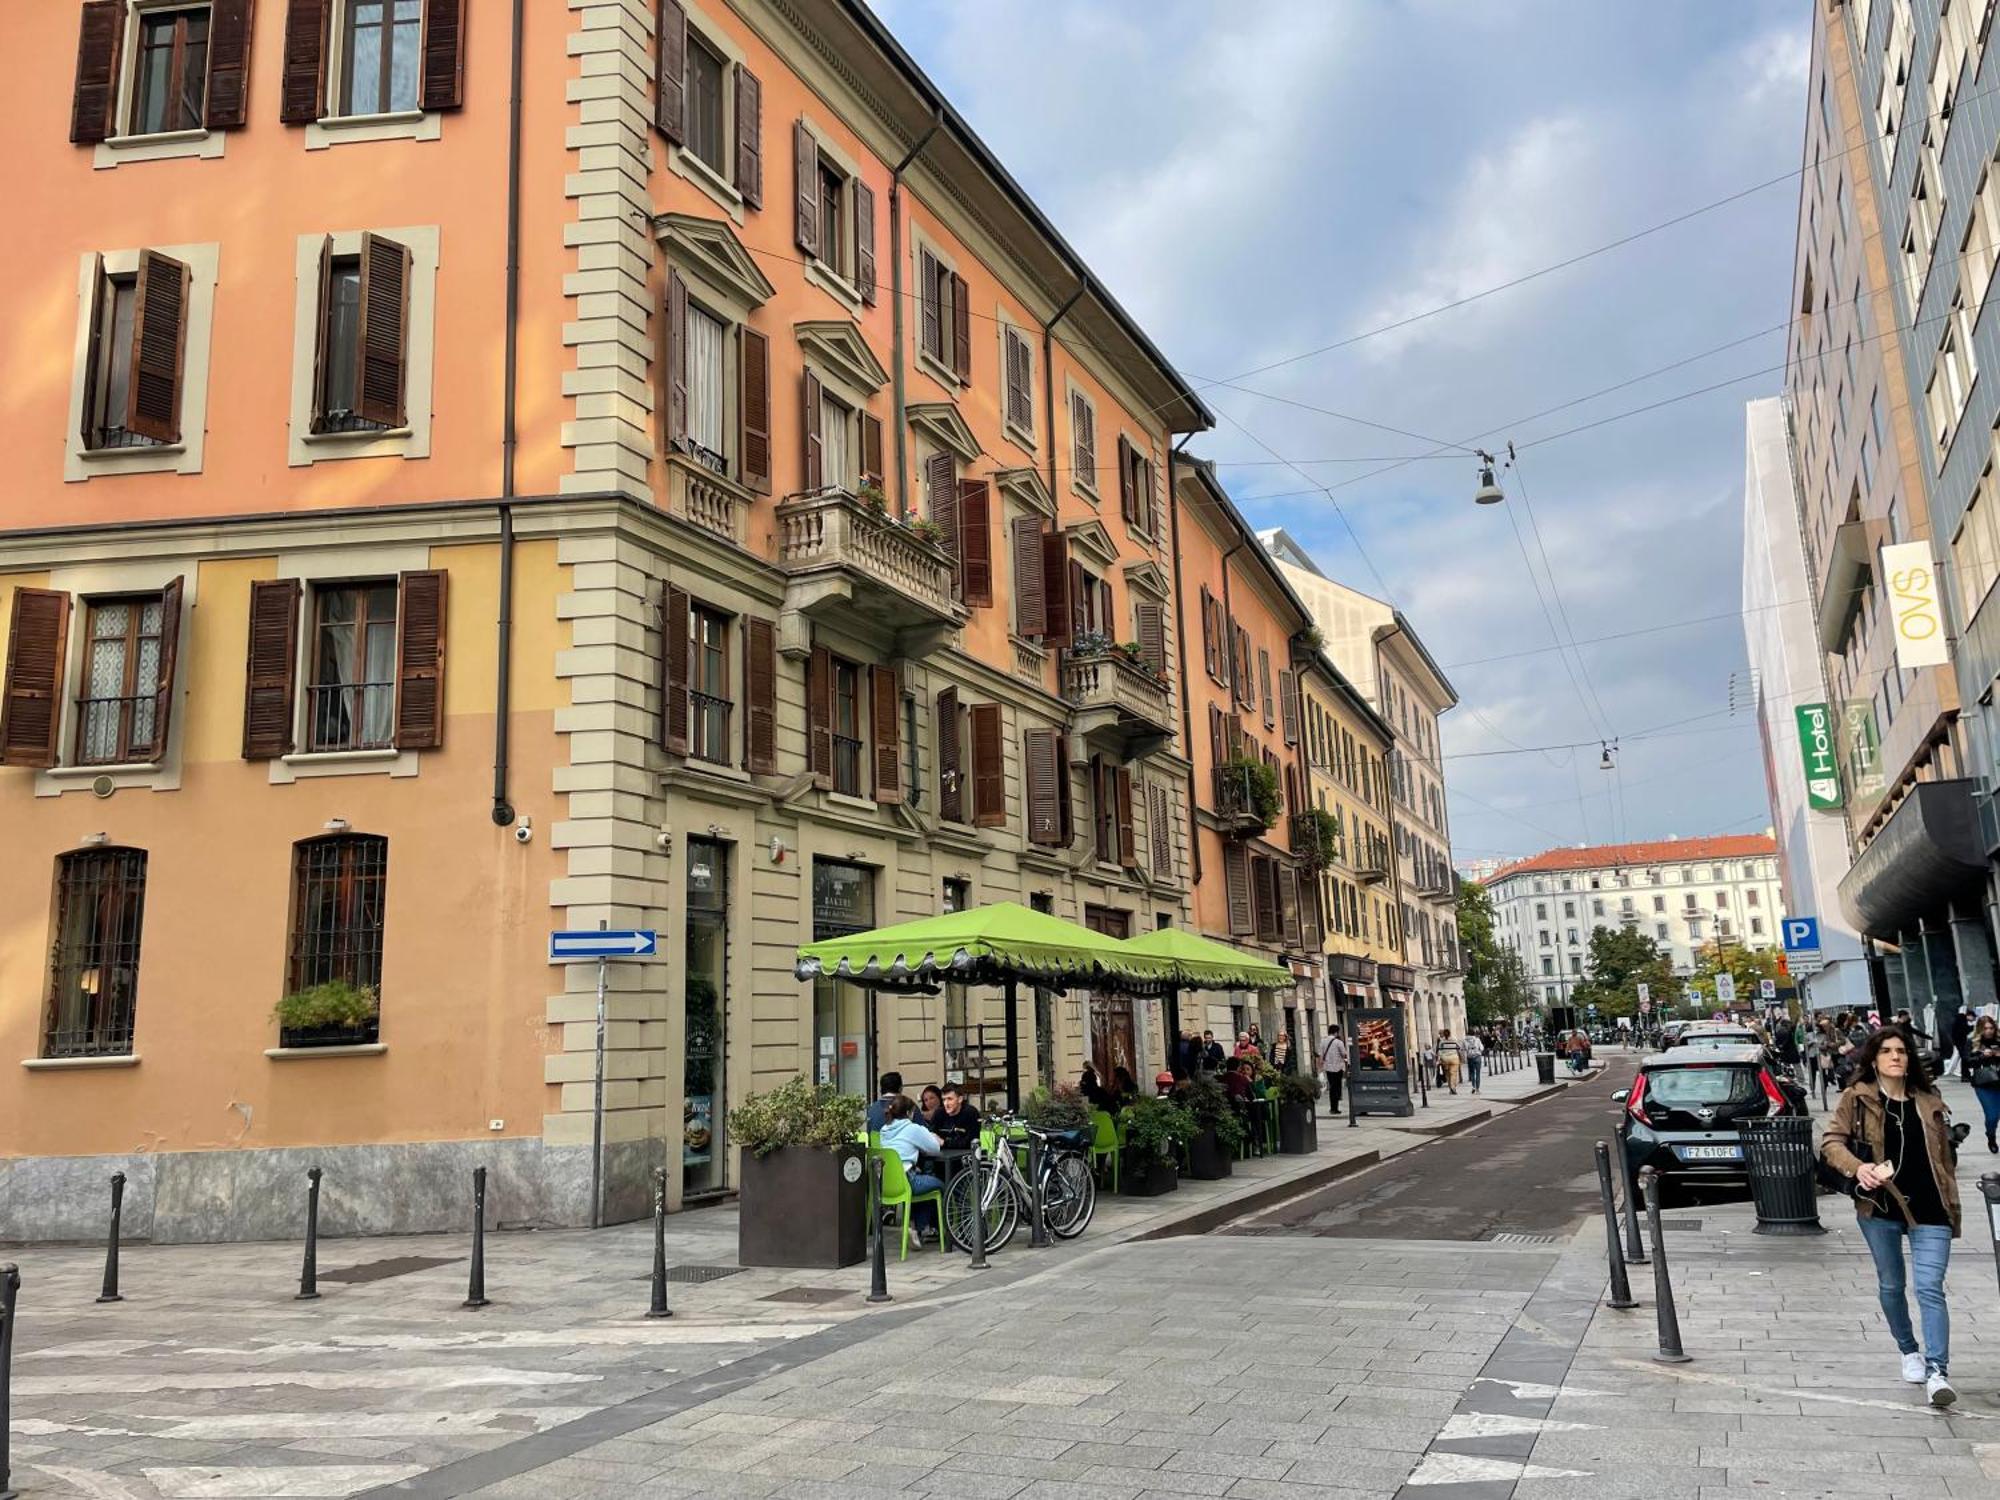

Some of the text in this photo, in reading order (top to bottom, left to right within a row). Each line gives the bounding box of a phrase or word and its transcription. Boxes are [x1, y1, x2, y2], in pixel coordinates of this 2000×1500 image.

[1892, 567, 1937, 641] OVS
[1804, 708, 1832, 773] Hotel
[1789, 922, 1810, 947] P
